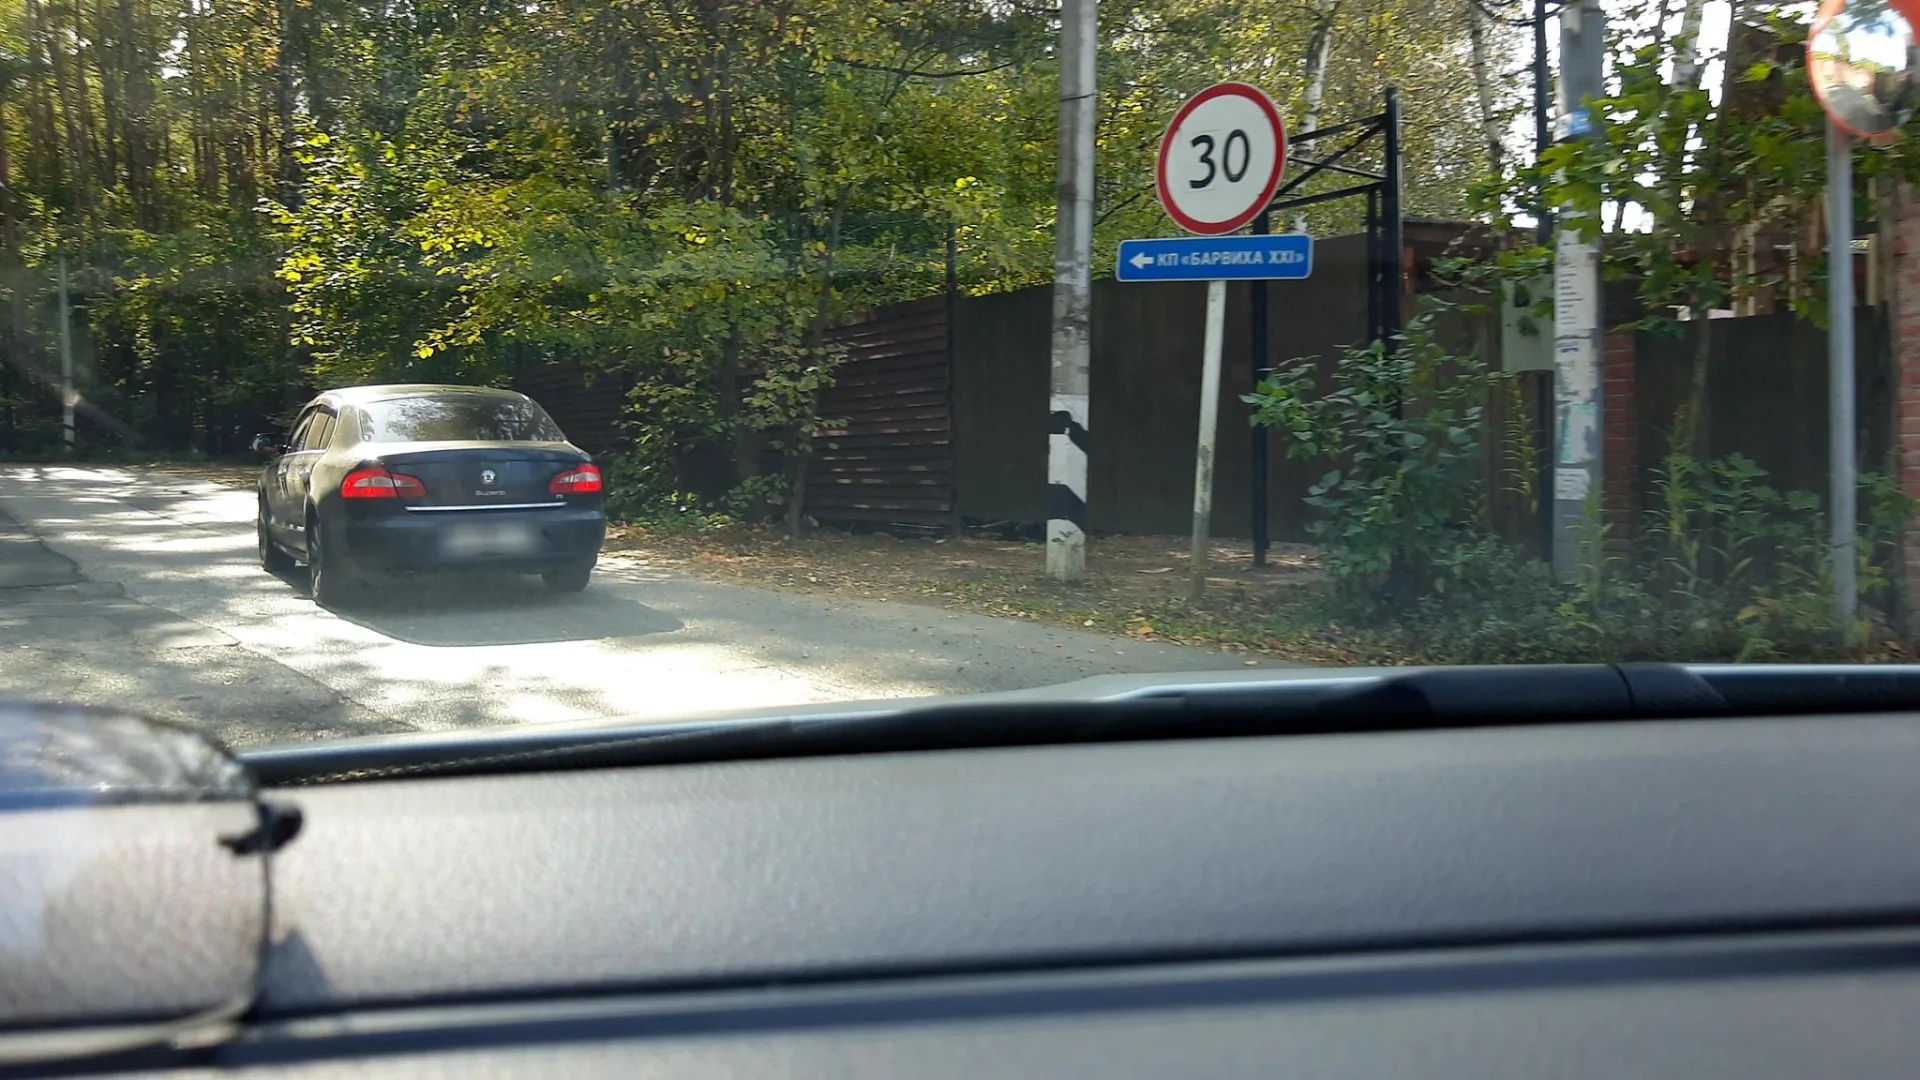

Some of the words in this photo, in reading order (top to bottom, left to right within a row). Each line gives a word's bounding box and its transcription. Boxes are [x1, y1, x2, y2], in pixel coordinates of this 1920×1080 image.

[1190, 129, 1250, 189] 30
[1157, 253, 1179, 266] КП
[1181, 251, 1264, 266] «БАРВИХА
